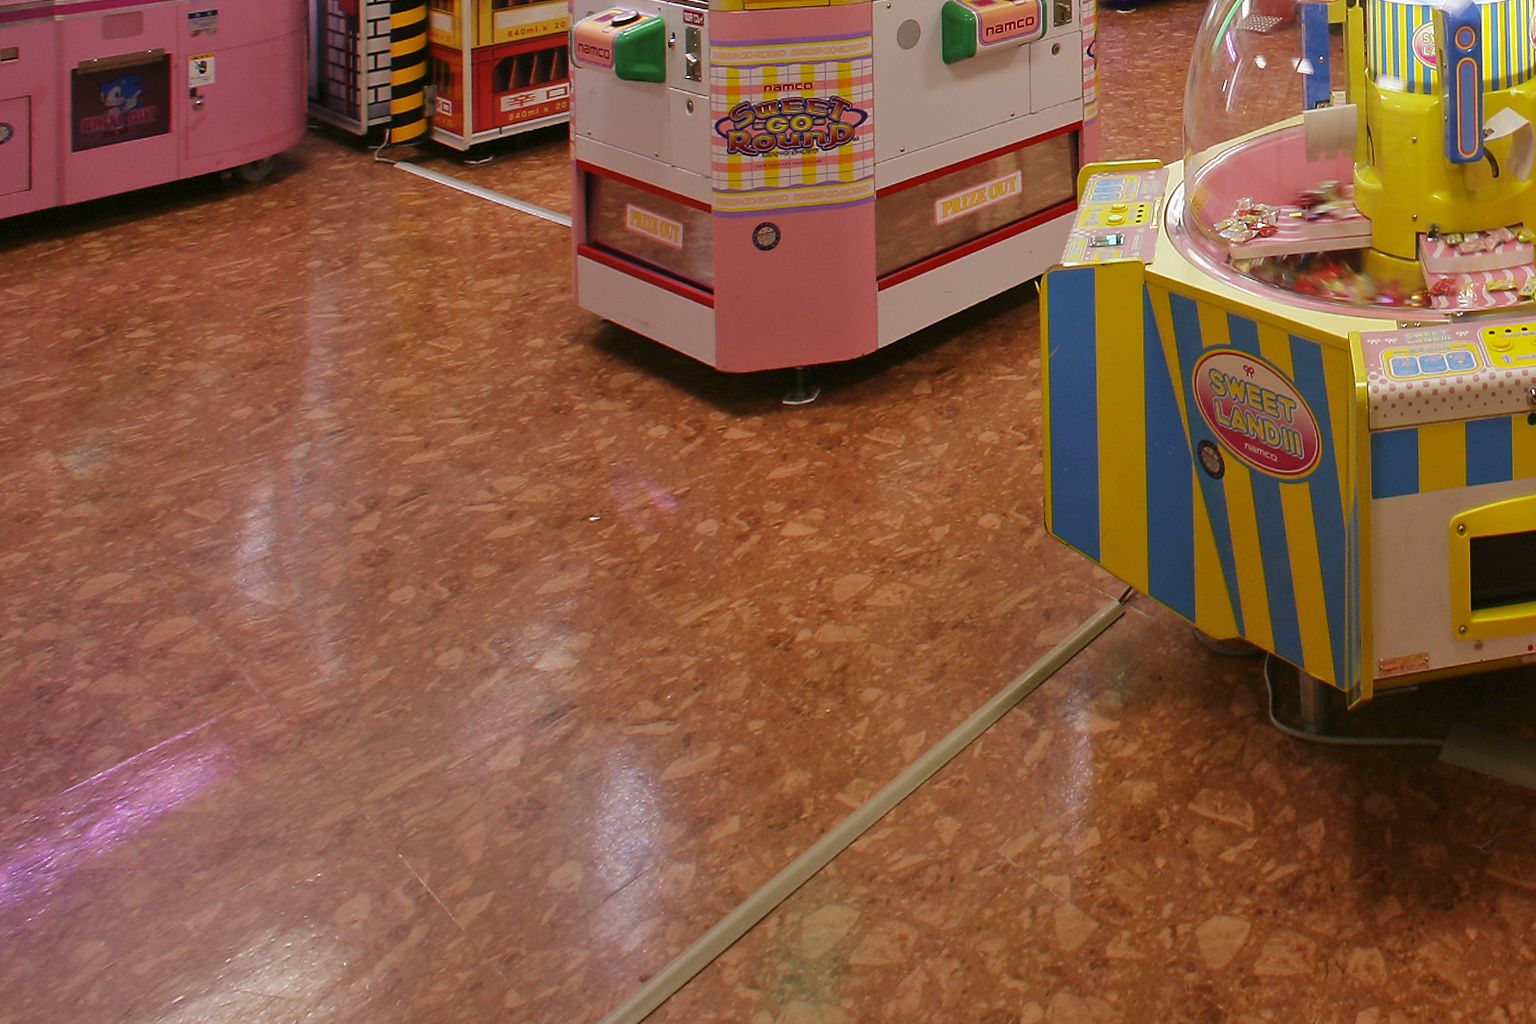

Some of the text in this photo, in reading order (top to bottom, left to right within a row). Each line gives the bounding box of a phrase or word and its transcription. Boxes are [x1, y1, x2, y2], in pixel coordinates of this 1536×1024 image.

[507, 27, 538, 39] 640ml
[554, 21, 566, 30] 20
[986, 16, 1035, 38] namco
[577, 42, 611, 60] namco
[763, 82, 814, 93] namco
[508, 108, 540, 120] 640ml
[555, 101, 567, 110] 20
[729, 95, 853, 131] SWEET
[941, 175, 1017, 218] PRIZE OUT
[1208, 367, 1298, 424] SWEET
[1244, 442, 1278, 463] namco
